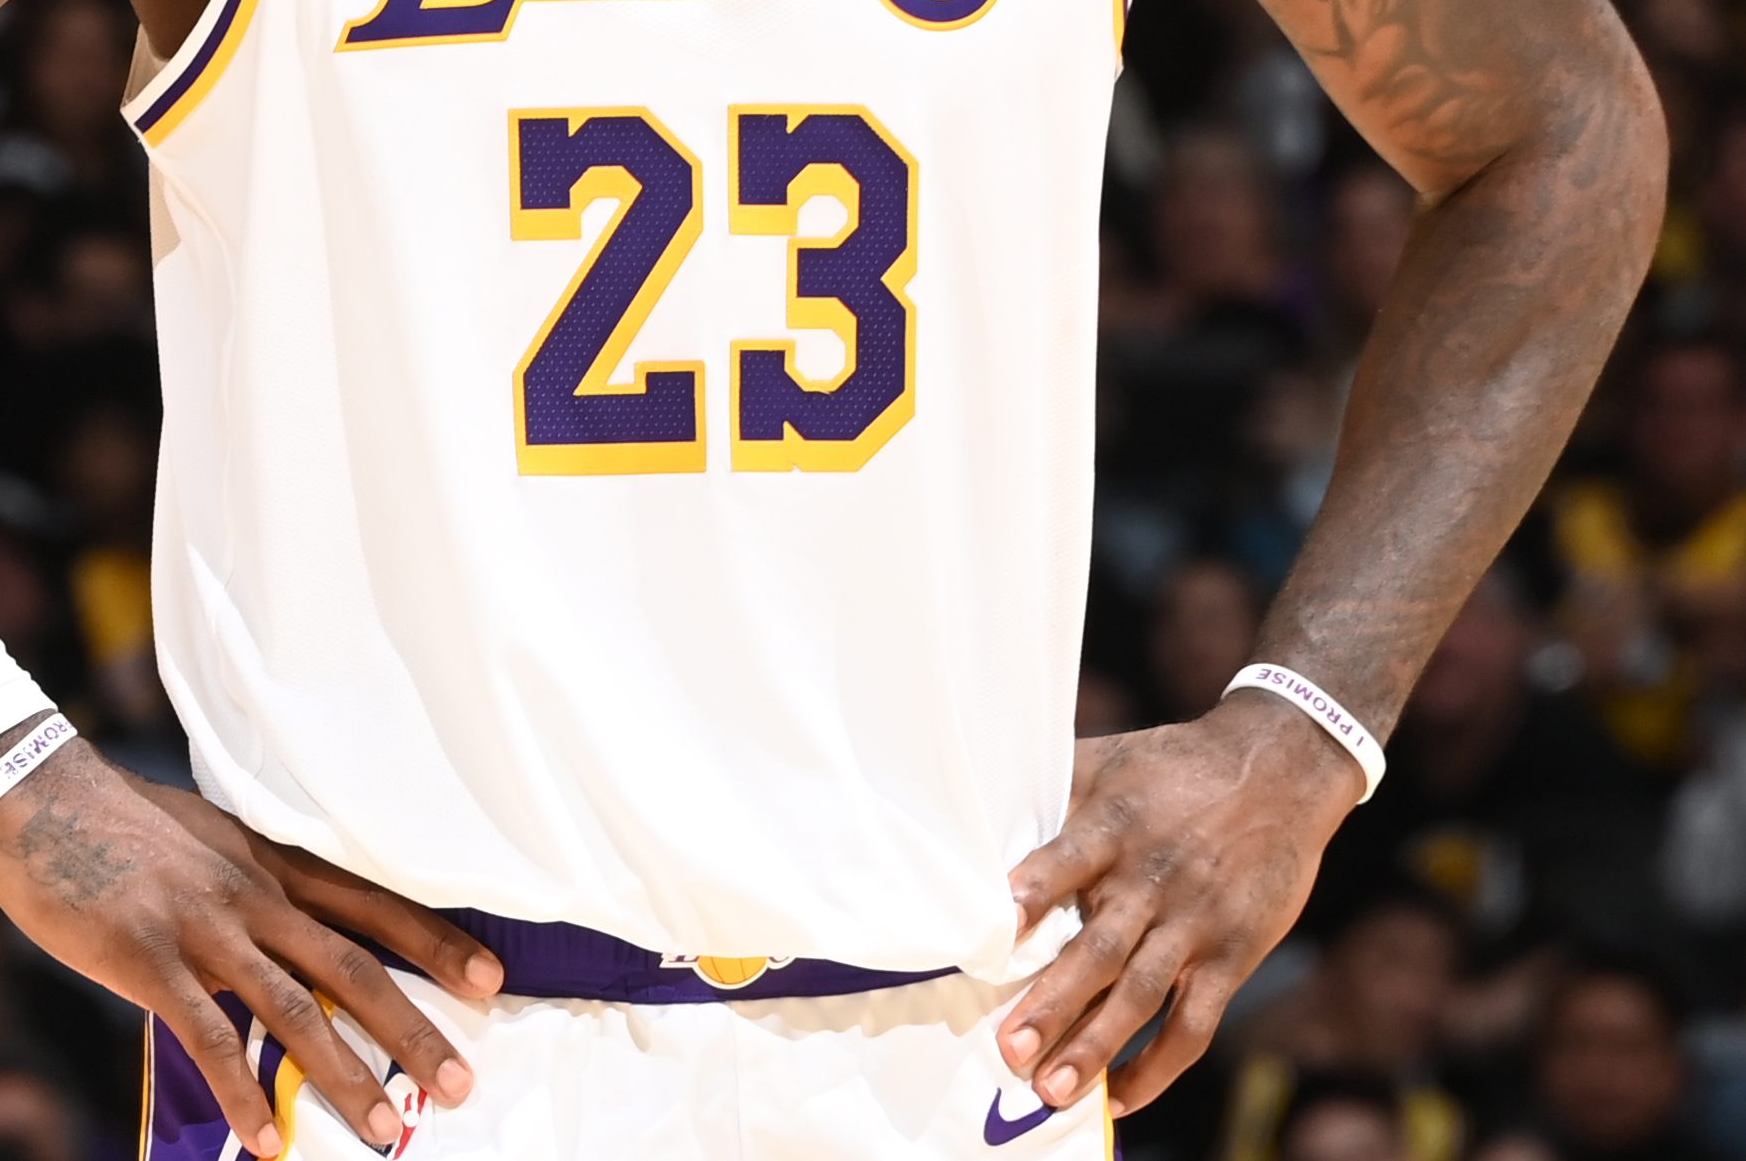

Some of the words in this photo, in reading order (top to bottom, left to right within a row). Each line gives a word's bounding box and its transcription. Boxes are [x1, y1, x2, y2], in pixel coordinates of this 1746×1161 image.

[507, 104, 919, 476] 23
[1256, 668, 1353, 735] PROMISE
[0, 720, 72, 779] ROMISE
